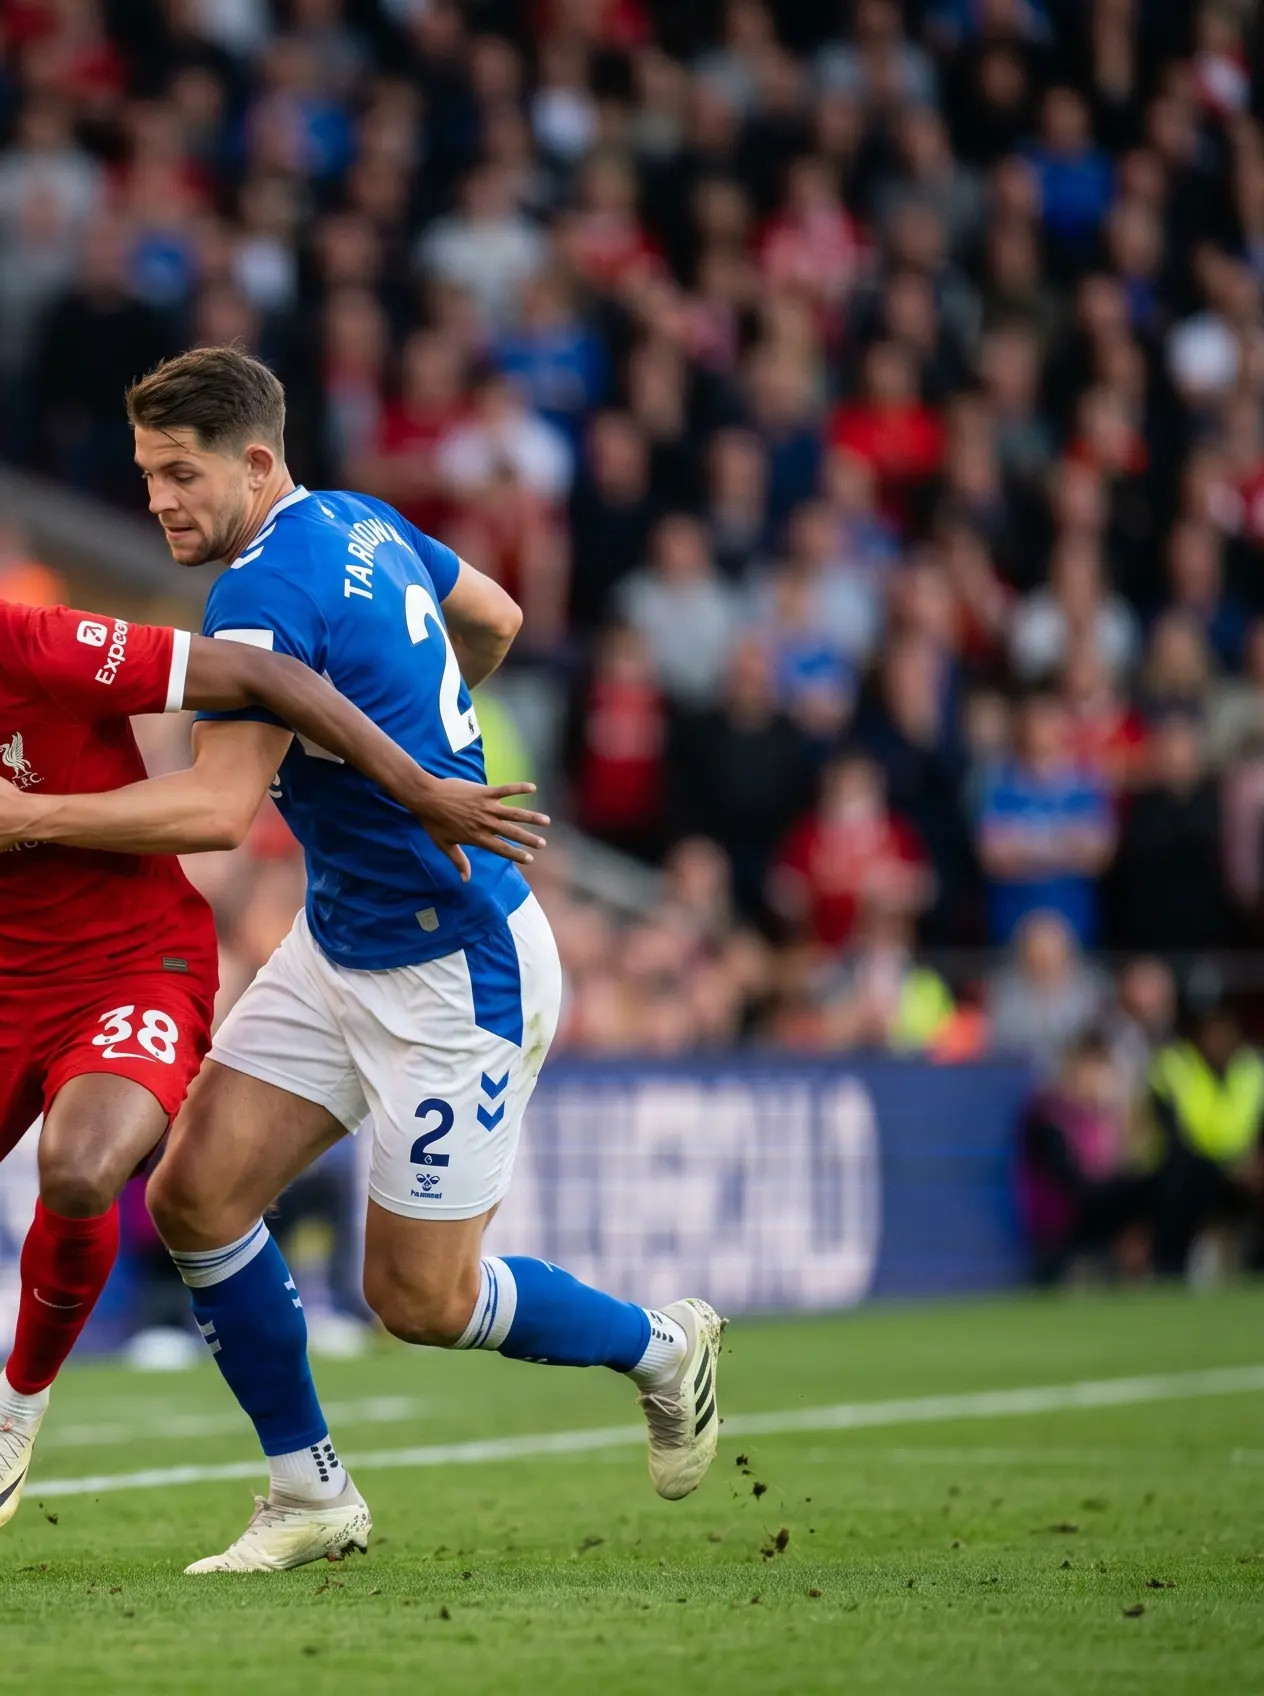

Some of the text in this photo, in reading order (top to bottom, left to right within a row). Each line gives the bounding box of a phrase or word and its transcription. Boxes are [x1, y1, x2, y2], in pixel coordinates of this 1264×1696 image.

[405, 583, 481, 753] 2
[91, 1004, 179, 1065] 38
[410, 1098, 455, 1167] 2
